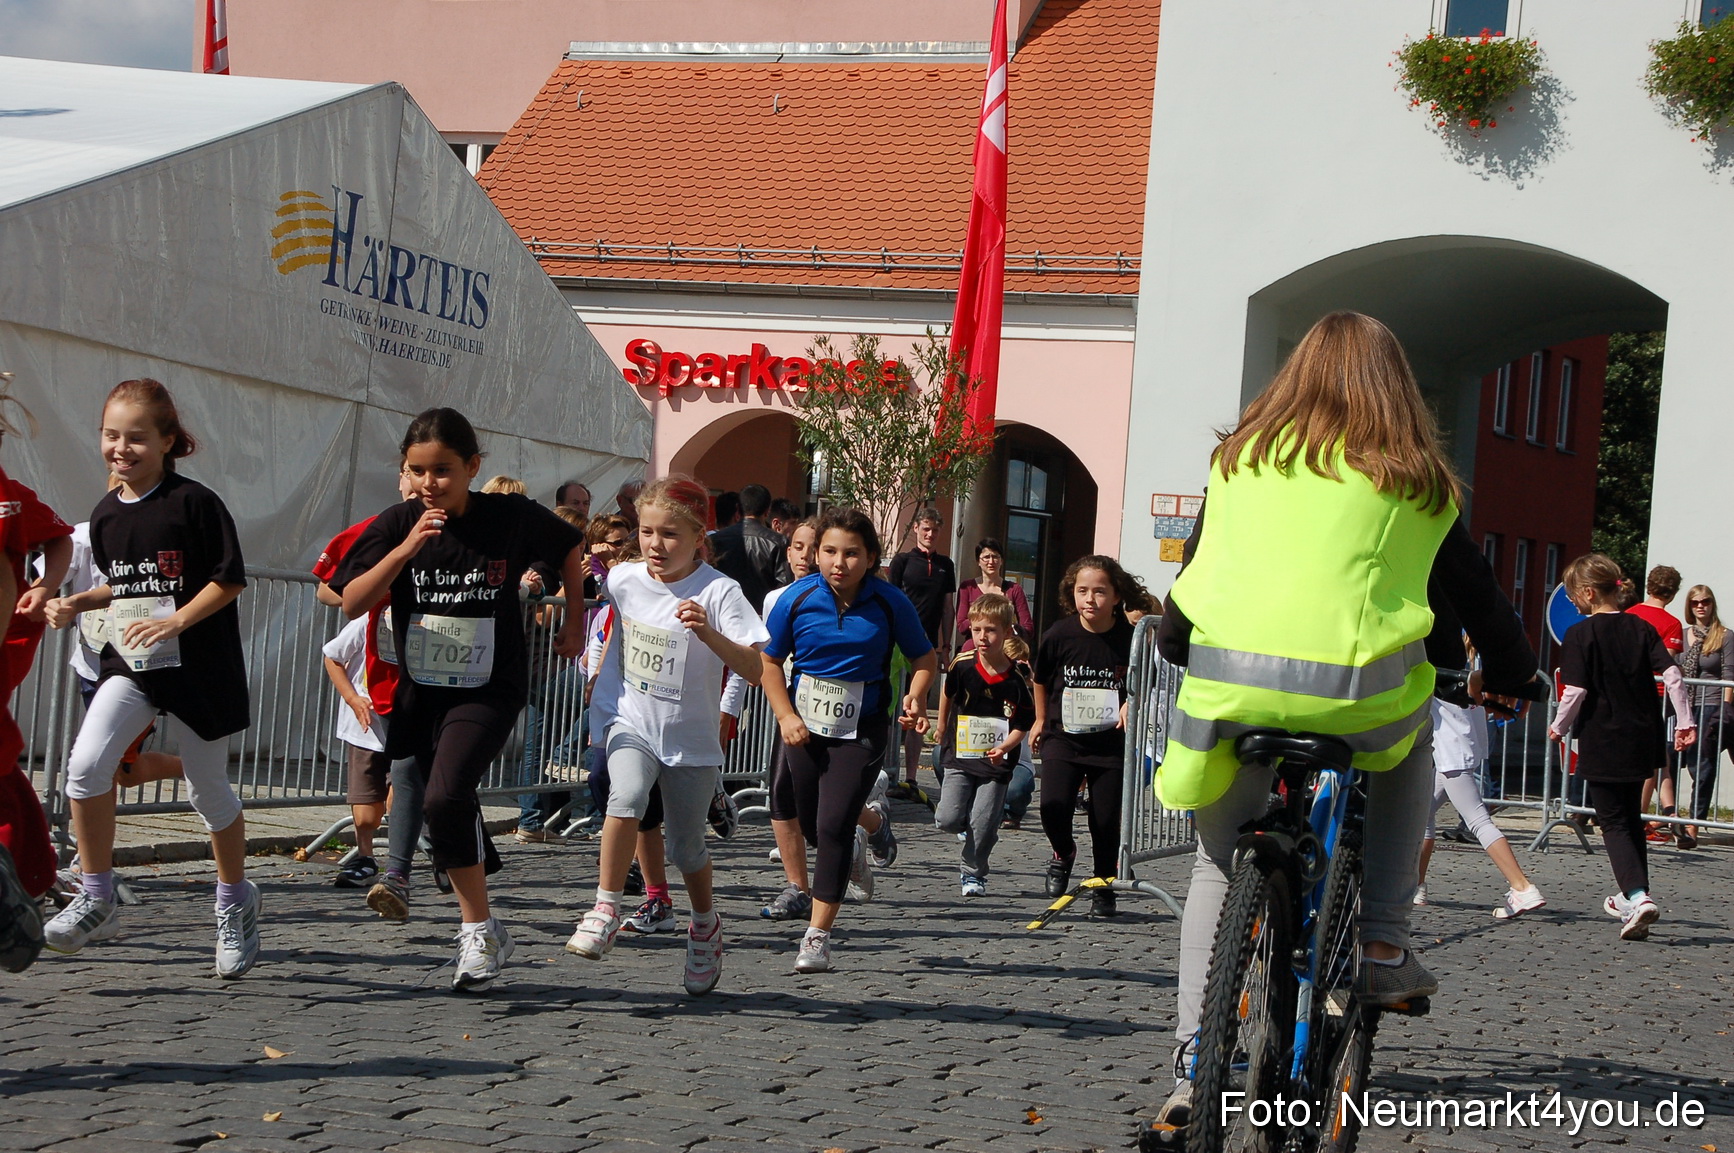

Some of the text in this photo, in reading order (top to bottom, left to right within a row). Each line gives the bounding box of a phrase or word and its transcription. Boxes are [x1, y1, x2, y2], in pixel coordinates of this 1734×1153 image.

[322, 185, 490, 330] HÄRTEIS
[379, 315, 418, 339] WEINE
[424, 327, 485, 357] ZELTVERLEIH
[623, 338, 910, 397] Sparkasse
[112, 558, 158, 578] bin ein
[412, 567, 485, 586] Ich bin ein
[115, 604, 150, 619] Camilla
[431, 621, 461, 637] Linda
[632, 624, 678, 650] Franziska
[431, 643, 487, 664] 7027
[631, 645, 676, 676] 7081
[1063, 665, 1115, 679] Ich bin ein
[812, 679, 844, 696] Mirjam
[812, 697, 856, 719] 7160
[1077, 706, 1115, 720] 7022
[970, 732, 1005, 745] 7284
